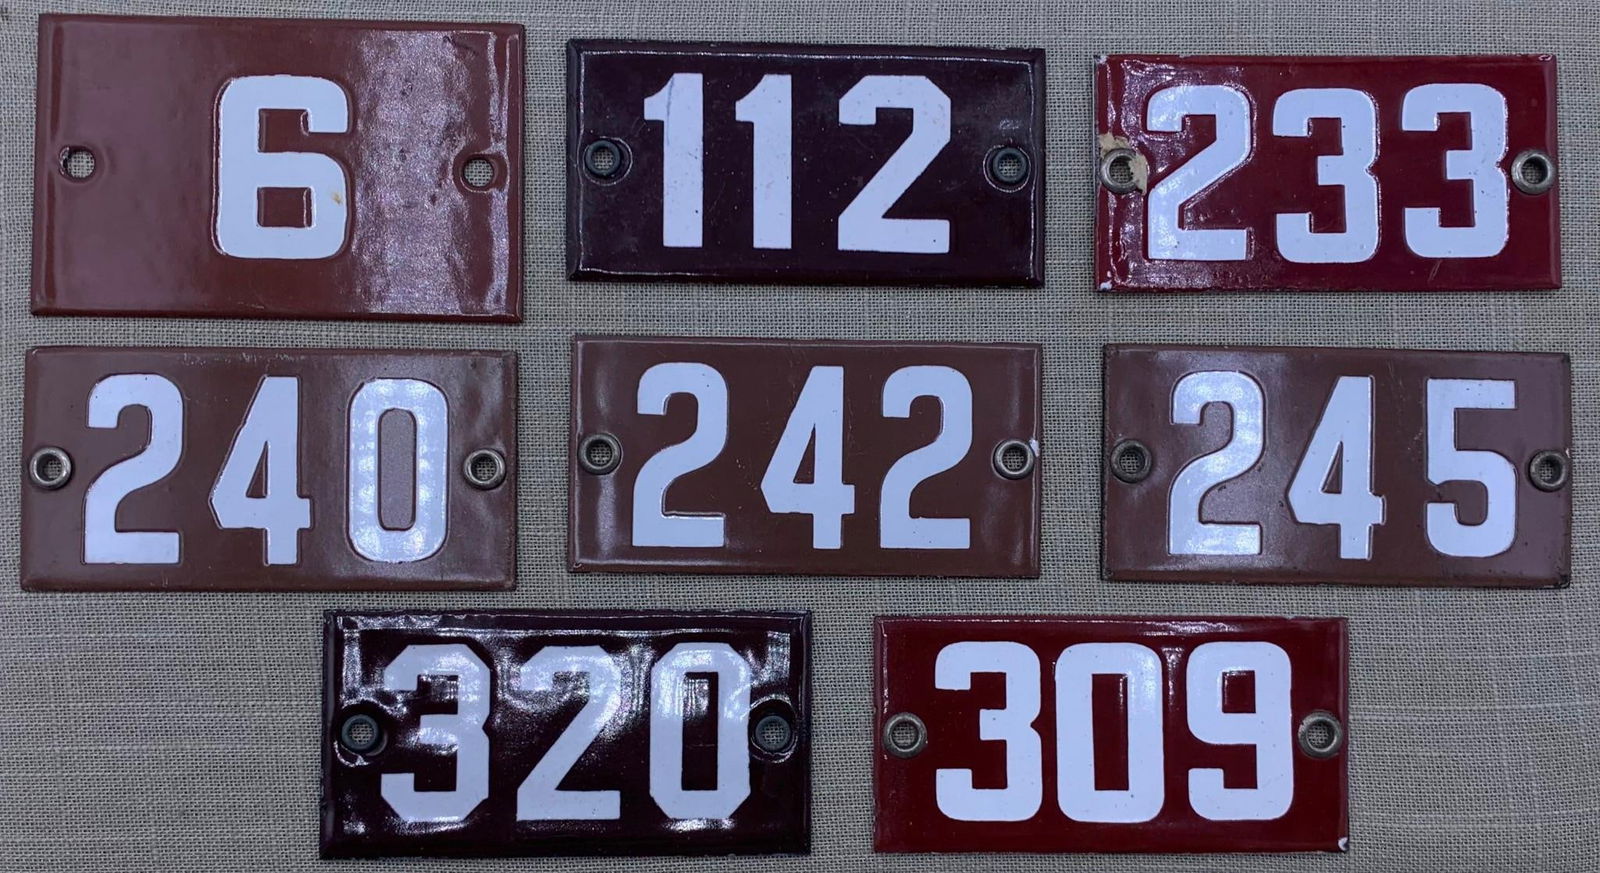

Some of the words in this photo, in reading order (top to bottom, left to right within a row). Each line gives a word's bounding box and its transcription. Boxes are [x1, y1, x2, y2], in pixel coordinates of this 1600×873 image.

[216, 75, 348, 259] 6
[645, 74, 950, 252] 112
[1147, 83, 1509, 263] 233
[85, 374, 447, 564] 240
[633, 363, 972, 549] 242
[1170, 370, 1515, 559] 245
[381, 643, 751, 823] 320
[935, 642, 1293, 823] 309
